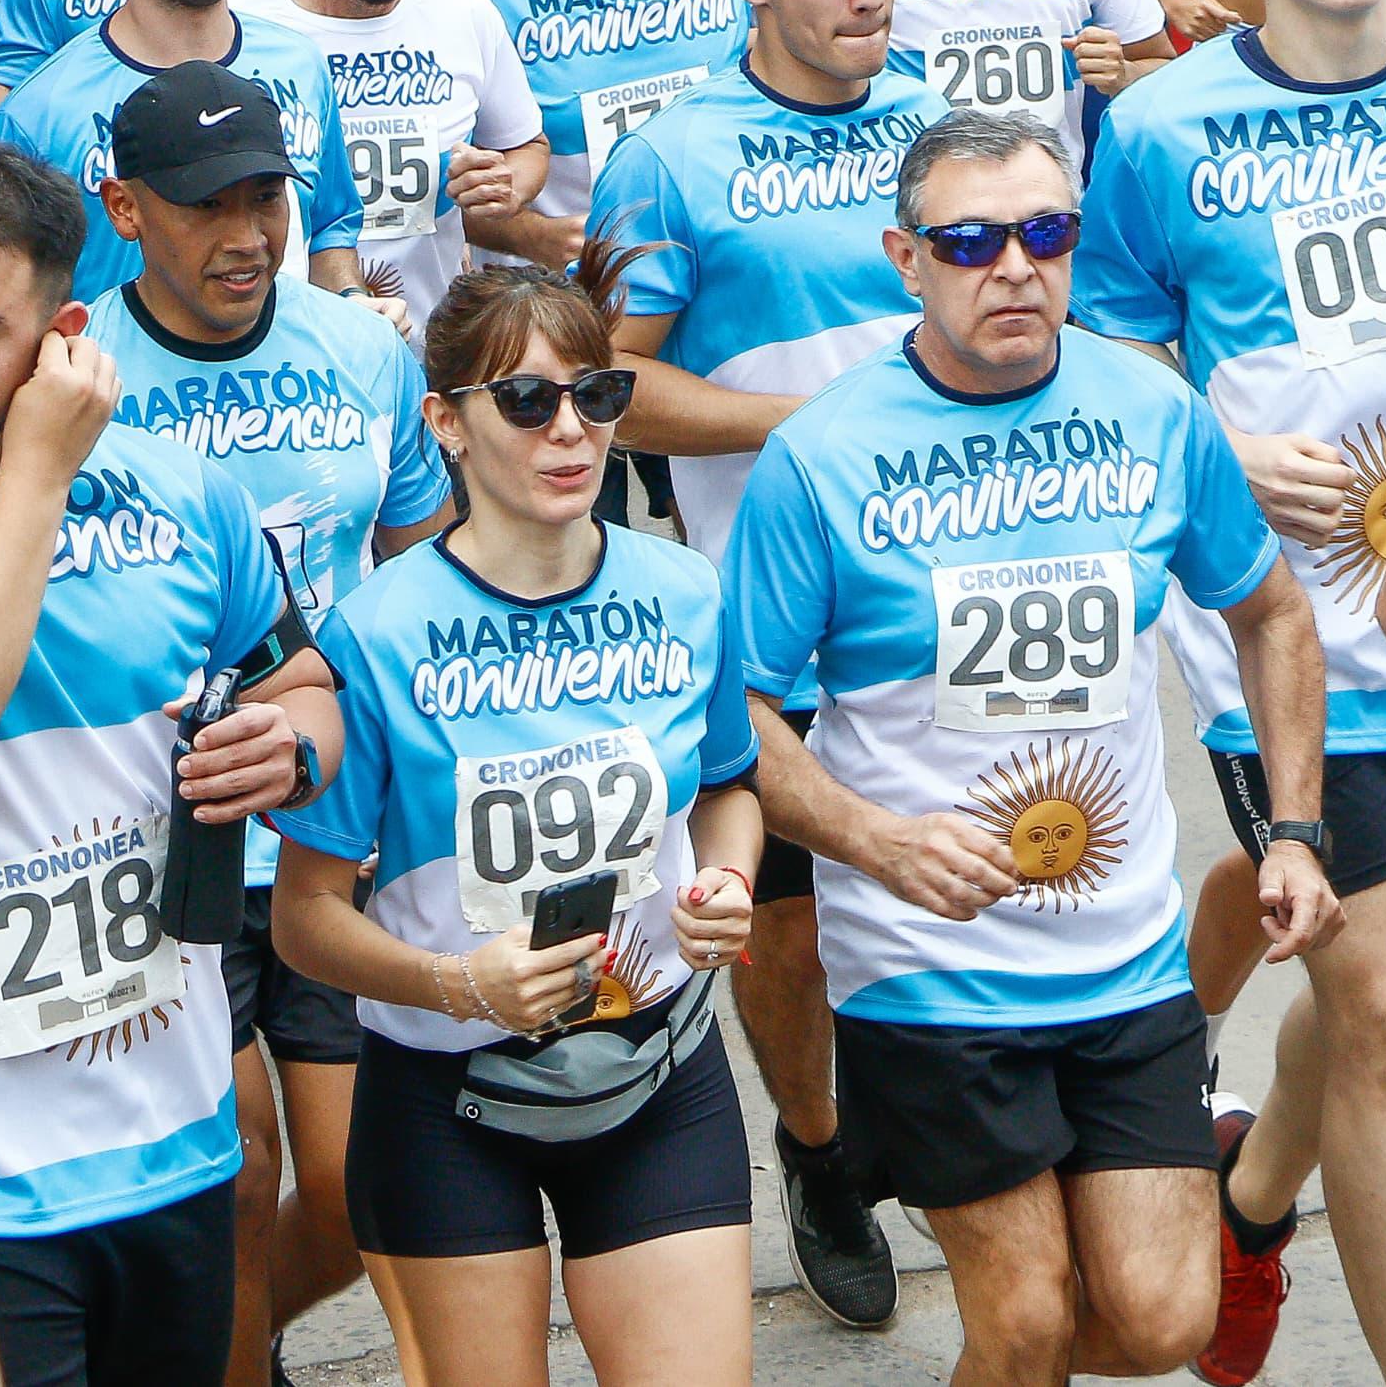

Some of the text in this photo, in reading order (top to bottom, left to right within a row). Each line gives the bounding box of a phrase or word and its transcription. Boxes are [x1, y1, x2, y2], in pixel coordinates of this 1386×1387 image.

[328, 44, 436, 75] RATÓN
[941, 25, 1042, 46] CRONONEA
[597, 73, 694, 109] CRONONEA
[933, 41, 1054, 108] 260
[737, 111, 924, 166] MARATÓN
[874, 407, 1125, 492] MARATÓN
[860, 447, 1159, 555] convivencia
[958, 559, 1108, 593] CRONONEA
[426, 589, 664, 660] MARATÓN
[947, 584, 1120, 687] 289
[413, 622, 695, 721] convivencia
[478, 735, 633, 787] CRONONEA
[470, 761, 655, 885] 092
